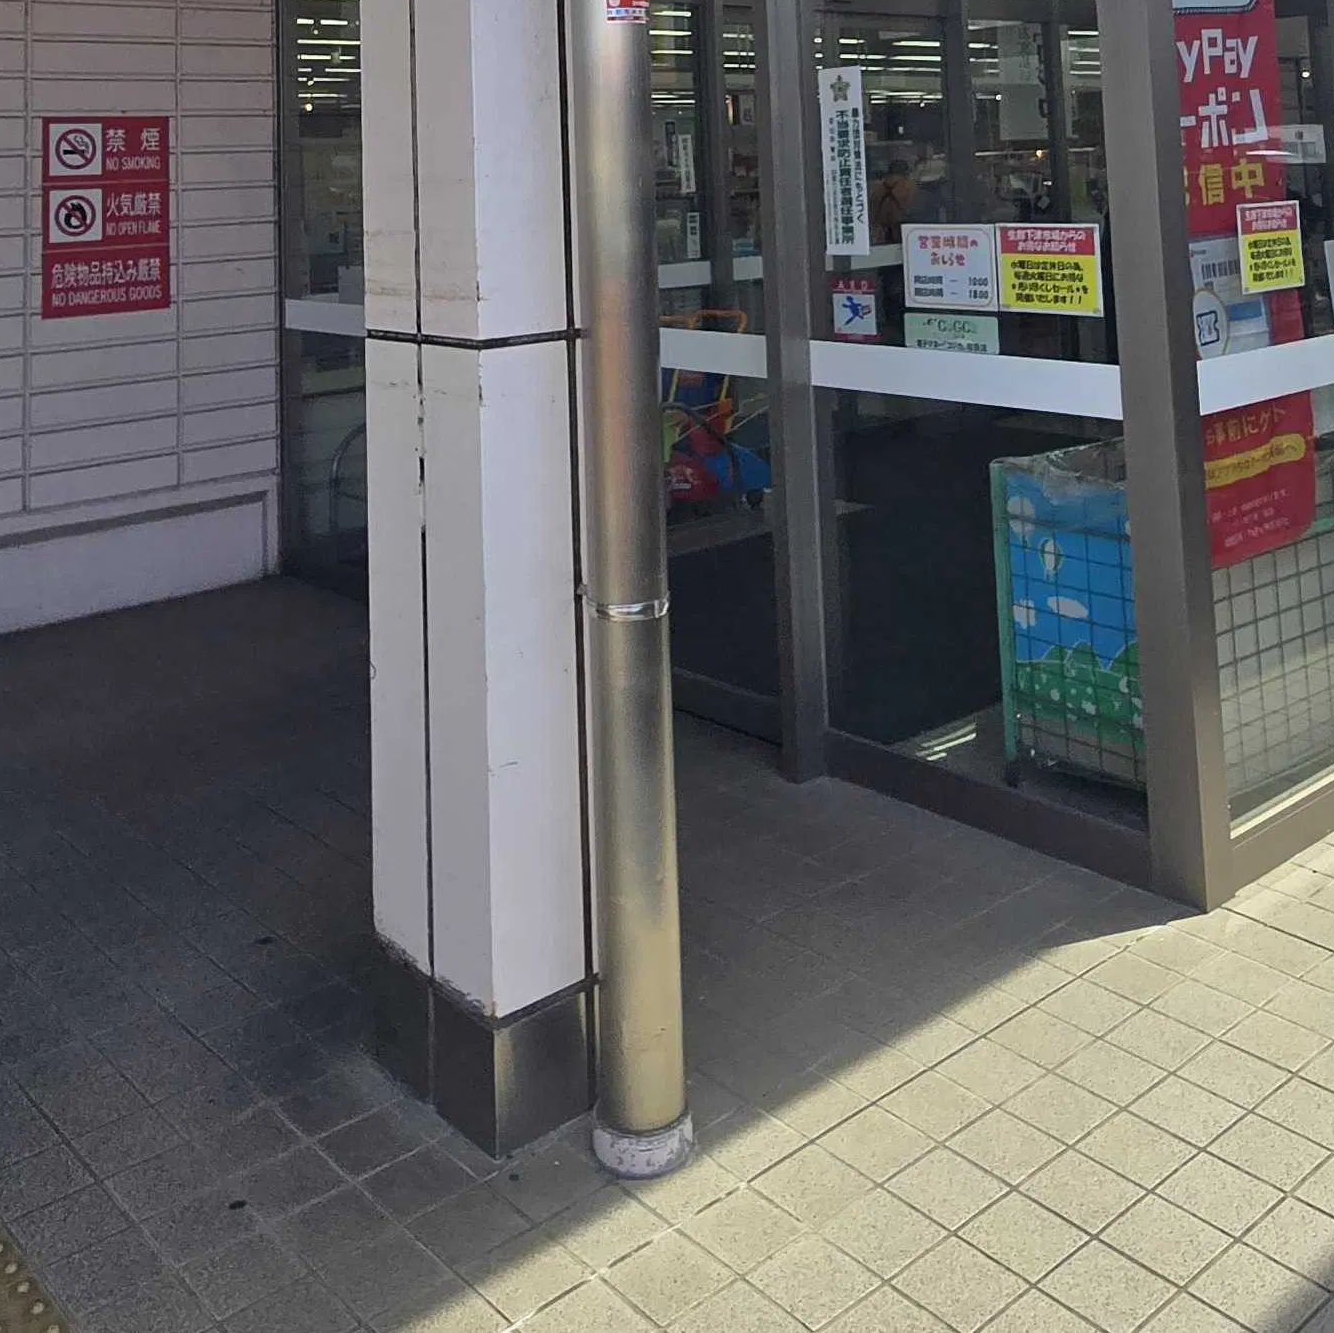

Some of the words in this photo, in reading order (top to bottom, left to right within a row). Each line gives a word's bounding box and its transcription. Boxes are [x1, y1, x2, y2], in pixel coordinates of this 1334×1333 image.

[106, 128, 160, 152] 禁煙
[106, 157, 118, 171] NO
[121, 156, 160, 170] SMOKING
[1184, 158, 1265, 205] 信中
[106, 192, 160, 217] 火気厳禁
[106, 222, 116, 235] NO
[52, 292, 65, 307] NO
[68, 287, 126, 306] DANGEROUS
[130, 285, 162, 301] GOODS
